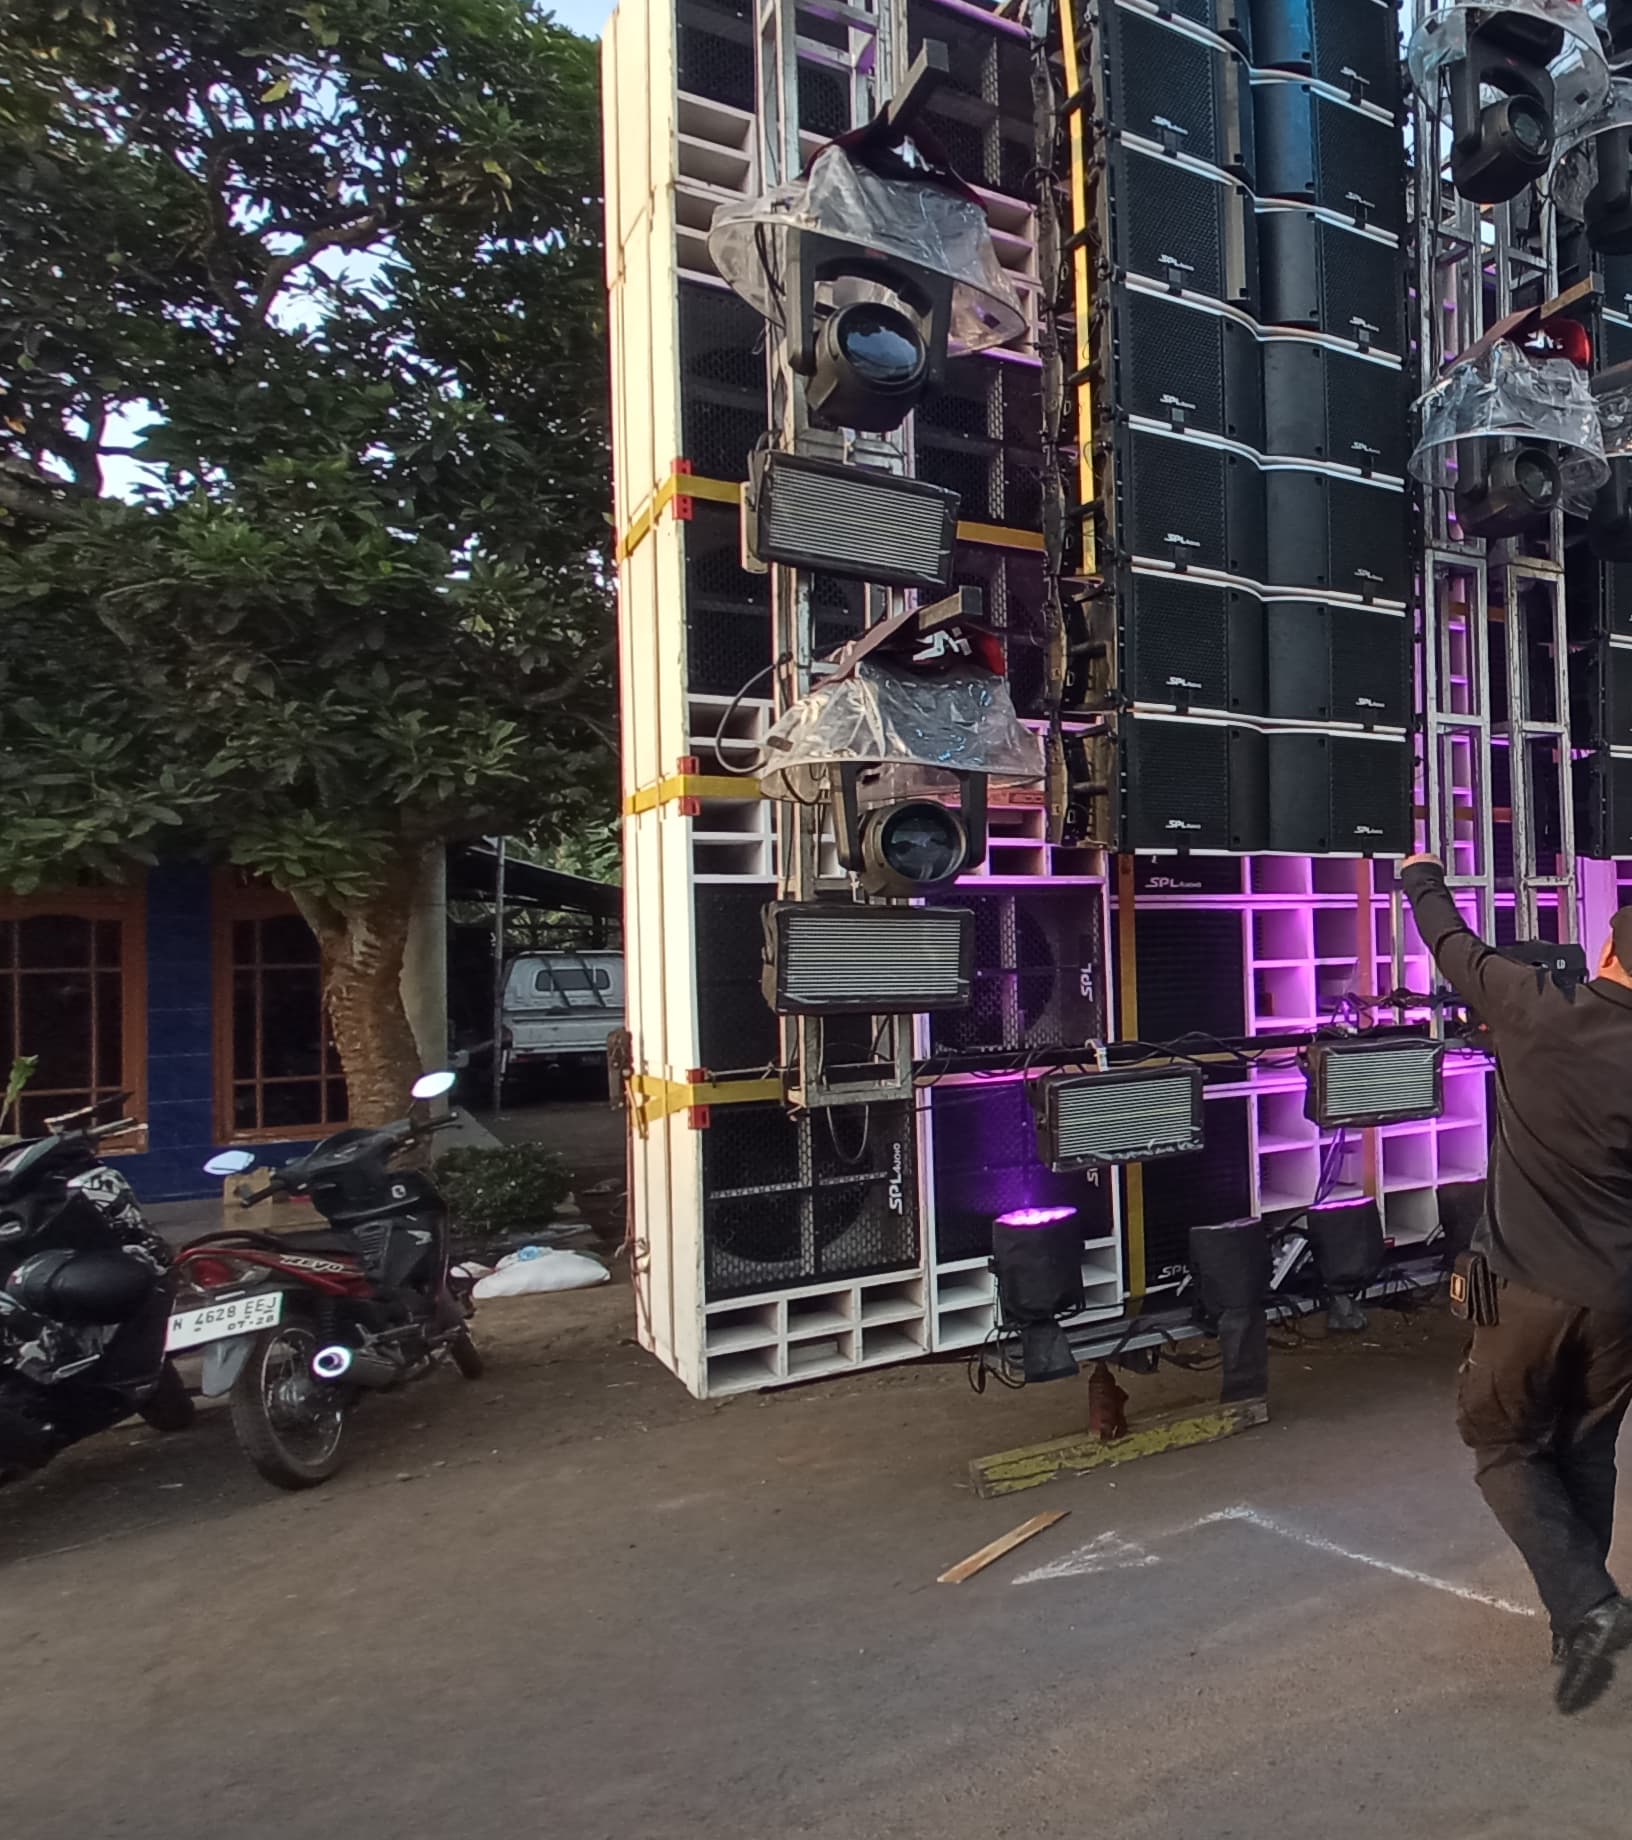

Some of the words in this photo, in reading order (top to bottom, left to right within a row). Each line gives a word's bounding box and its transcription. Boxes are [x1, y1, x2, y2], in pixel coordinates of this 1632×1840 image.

[1145, 876, 1178, 888] SPL
[1080, 963, 1093, 1002] SPL
[889, 1173, 903, 1216] SPL
[172, 1318, 183, 1331] N
[194, 1305, 236, 1326] 4628
[244, 1297, 277, 1315] EEJ
